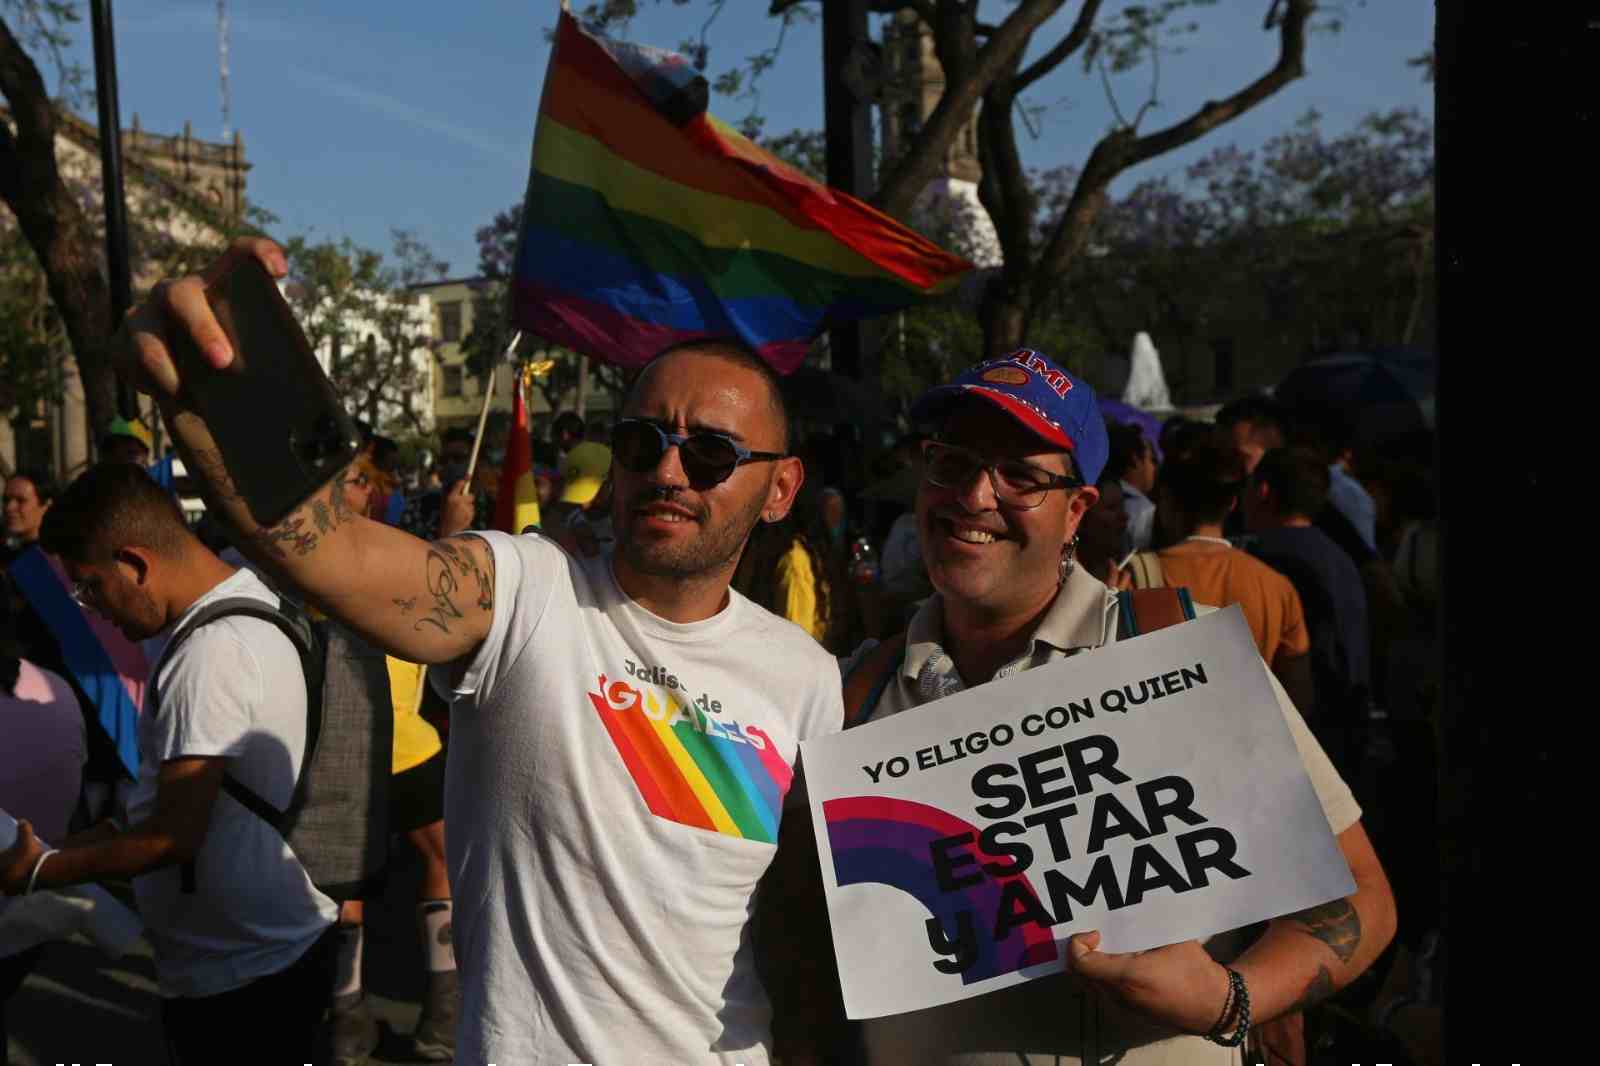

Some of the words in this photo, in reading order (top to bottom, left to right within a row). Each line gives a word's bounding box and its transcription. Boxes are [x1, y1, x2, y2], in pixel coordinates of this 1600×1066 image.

[984, 349, 1073, 400] AMI
[624, 658, 690, 694] Jalis
[862, 756, 909, 784] YO
[916, 724, 1014, 771] ELIGO
[1020, 698, 1095, 737] CON
[1101, 663, 1208, 714] QUIEN
[971, 734, 1131, 820] SER
[929, 775, 1208, 893] ESTAR
[993, 826, 1252, 942] AMAR
